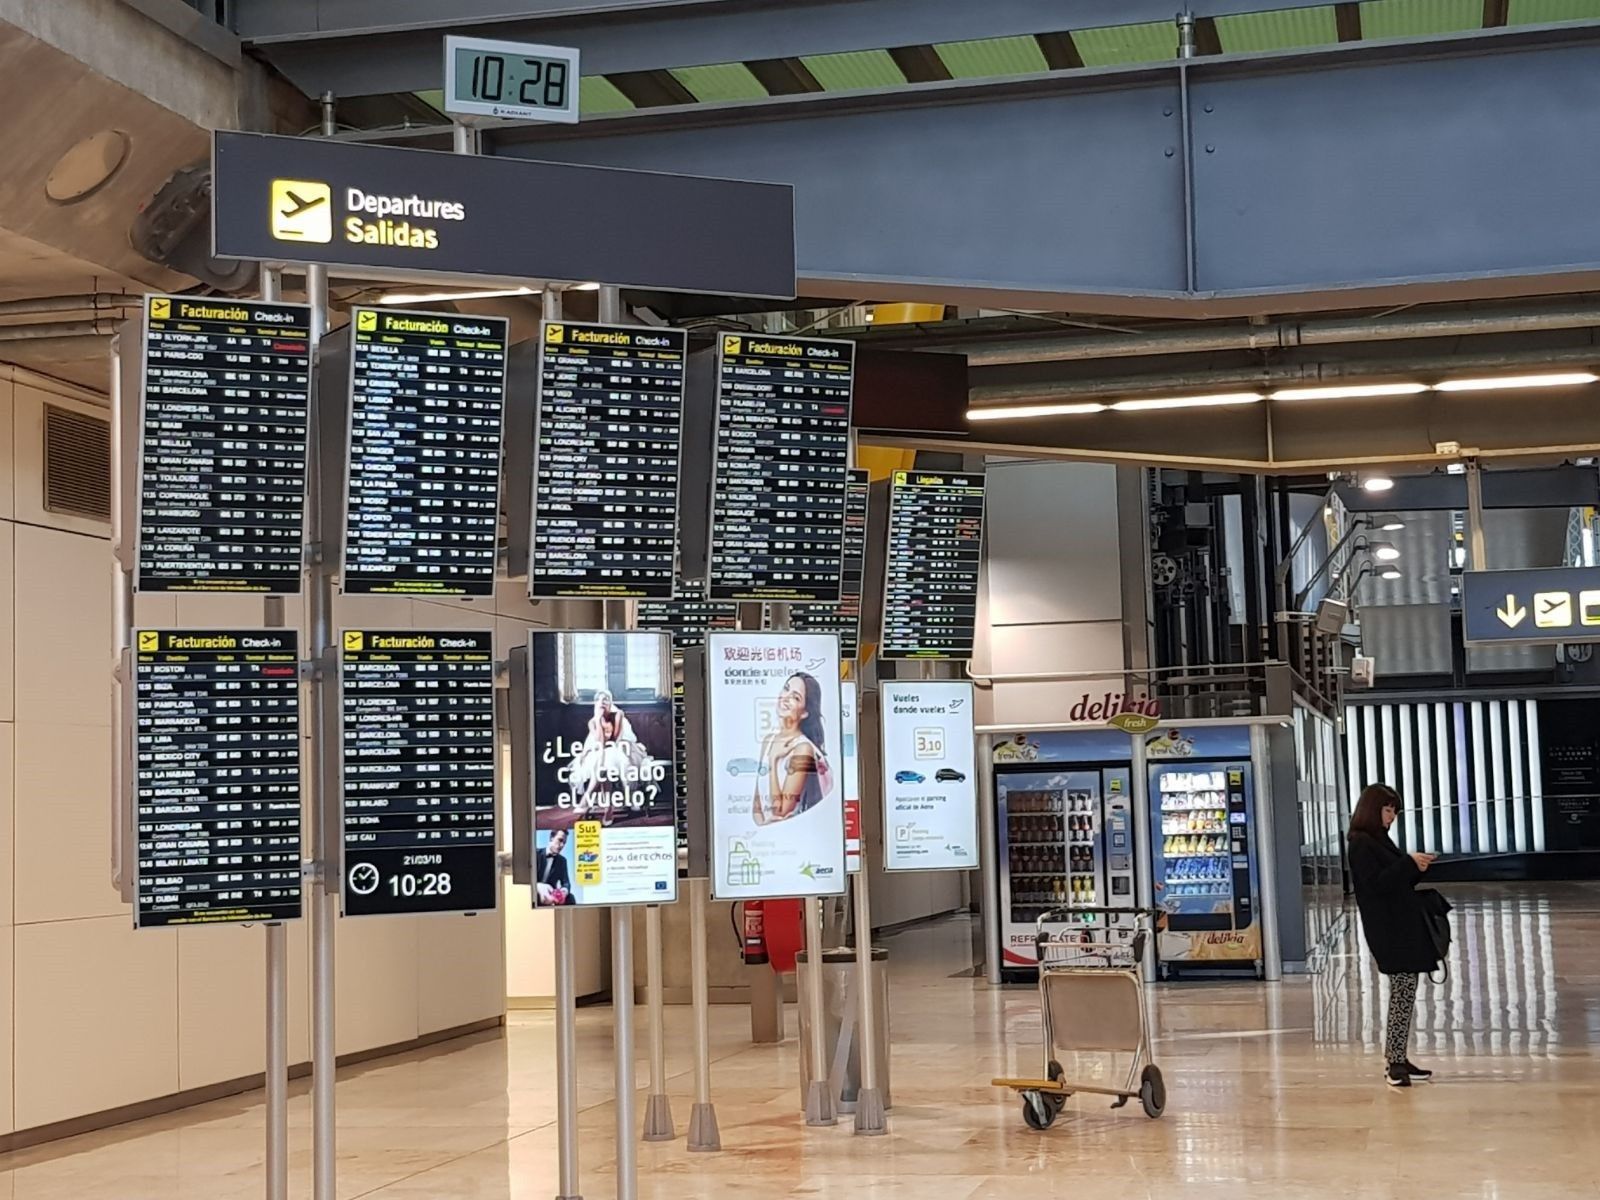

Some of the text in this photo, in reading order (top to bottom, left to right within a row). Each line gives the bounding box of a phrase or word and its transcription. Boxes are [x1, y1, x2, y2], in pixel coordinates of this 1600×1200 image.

[472, 56, 565, 106] 10:28
[348, 188, 465, 220] Departures
[346, 217, 438, 249] Salidas
[181, 305, 294, 322] Facturación Check-in
[385, 317, 490, 335] Facturación Check-in
[572, 329, 670, 346] Facturación Check-in
[749, 341, 839, 357] Facturación Check-in
[163, 369, 208, 378] BARCELONA
[162, 386, 208, 395] BARCELONA
[169, 635, 281, 648] Facturación Check-in
[372, 636, 476, 647] Facturación Check-in
[893, 694, 919, 702] Vueles
[1070, 692, 1160, 721] delikia
[1124, 718, 1146, 727] fresh
[543, 736, 583, 763] ¿Le
[918, 737, 941, 751] 3,10
[155, 788, 200, 796] BARCELONA
[586, 785, 657, 807] vuelo?
[579, 824, 596, 833] Sus
[404, 855, 442, 865] 21/03/18
[389, 873, 451, 896] 10:28
